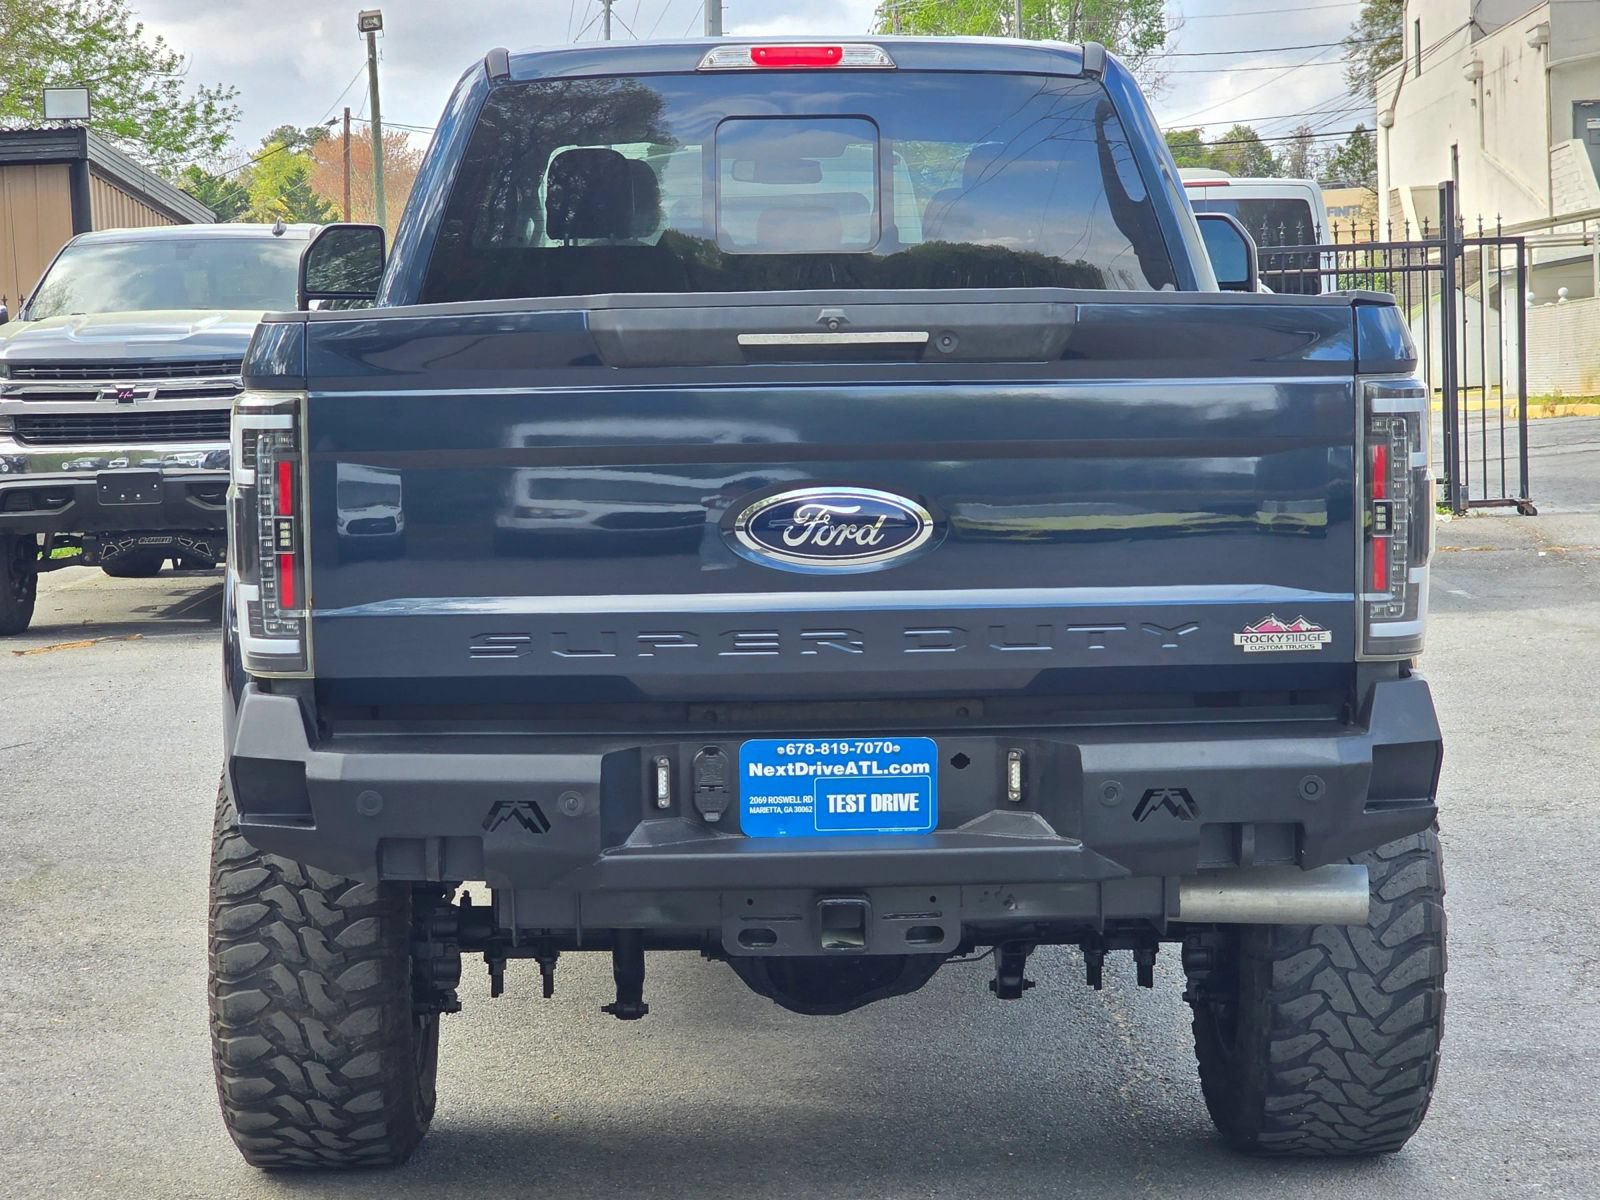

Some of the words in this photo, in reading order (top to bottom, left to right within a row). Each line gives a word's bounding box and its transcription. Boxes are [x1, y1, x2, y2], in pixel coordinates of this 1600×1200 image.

[782, 504, 887, 547] Ford
[469, 628, 864, 659] SUPER
[903, 621, 1200, 653] DUTY
[786, 742, 893, 755] 678-819-7070
[748, 761, 930, 777] NextDriveATL.com
[749, 796, 767, 805] 2069
[768, 795, 802, 804] ROSWELL
[803, 795, 814, 804] RD
[826, 794, 866, 813] TEST
[870, 793, 919, 812] DRIVE
[749, 806, 783, 814] MARIETTA,
